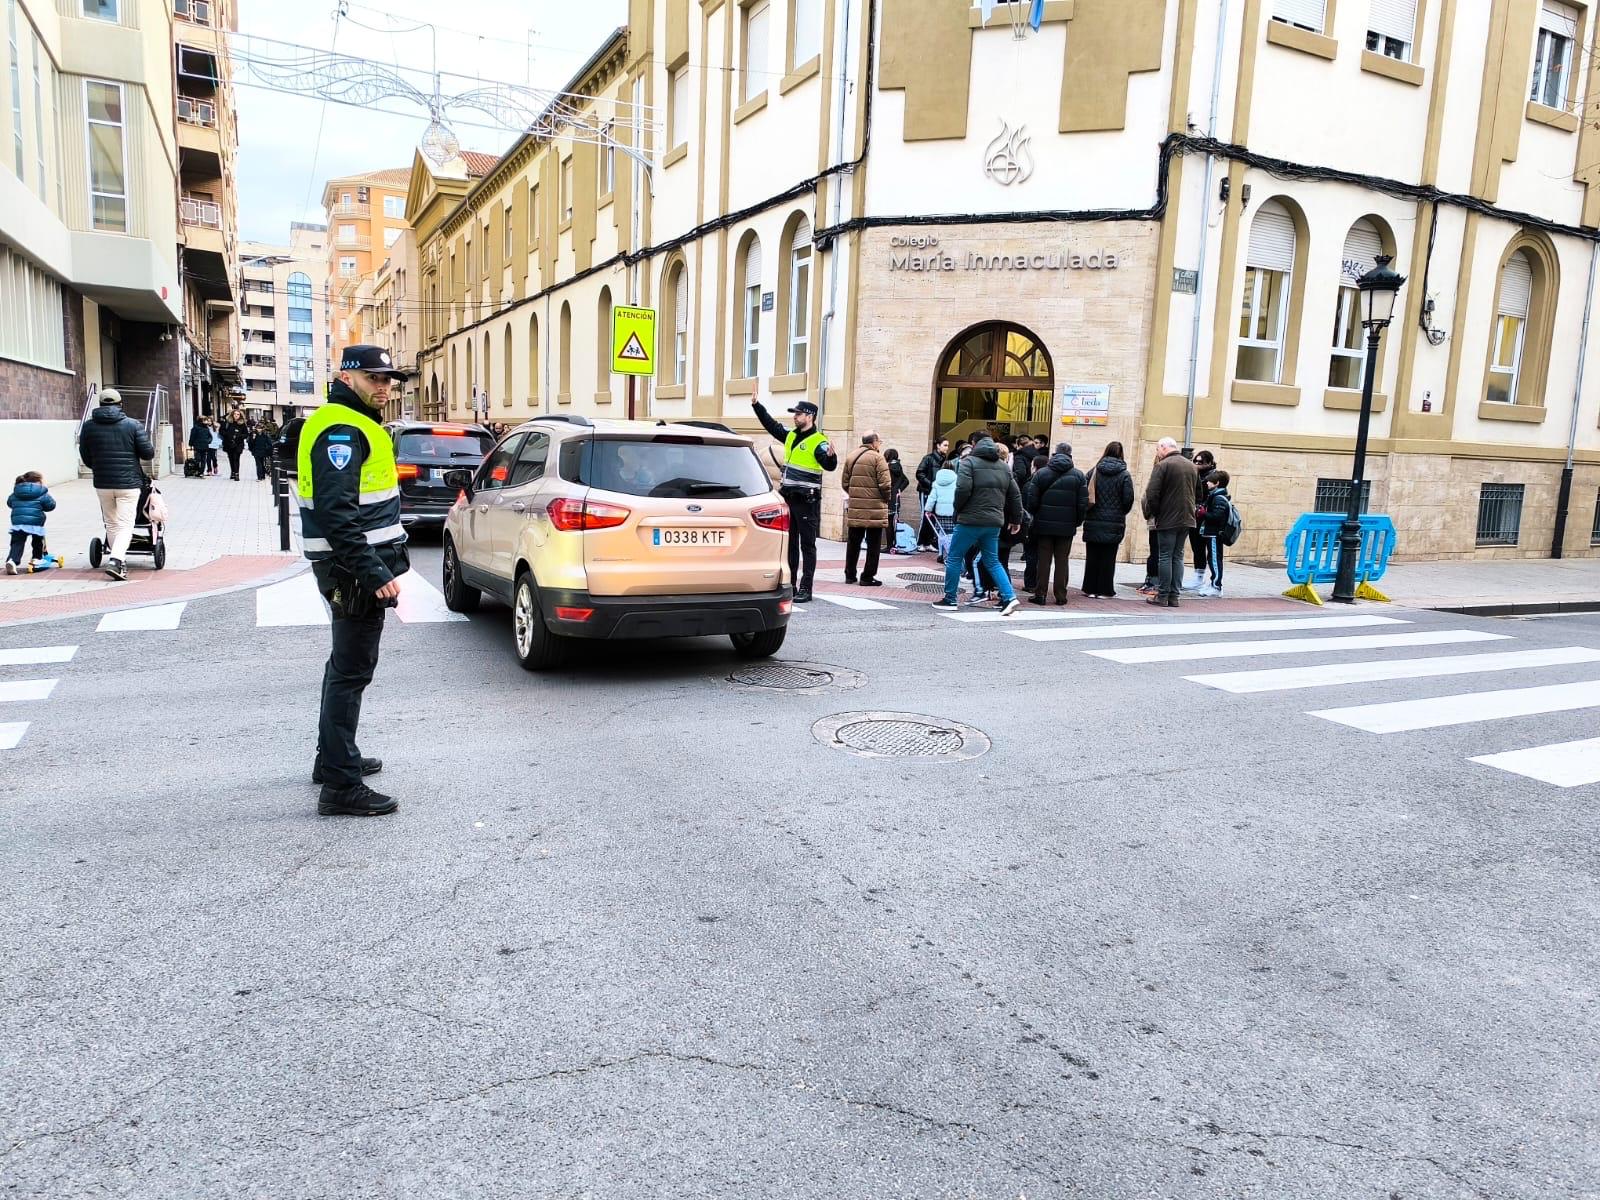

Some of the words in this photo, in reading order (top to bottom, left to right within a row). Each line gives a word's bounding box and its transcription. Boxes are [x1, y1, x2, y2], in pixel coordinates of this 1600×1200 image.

[889, 234, 939, 249] Colegio
[888, 250, 956, 272] María
[964, 247, 1120, 271] Inmaculada
[617, 310, 653, 321] ATENCIÓN
[664, 530, 698, 544] 0338
[702, 531, 726, 544] KTF
